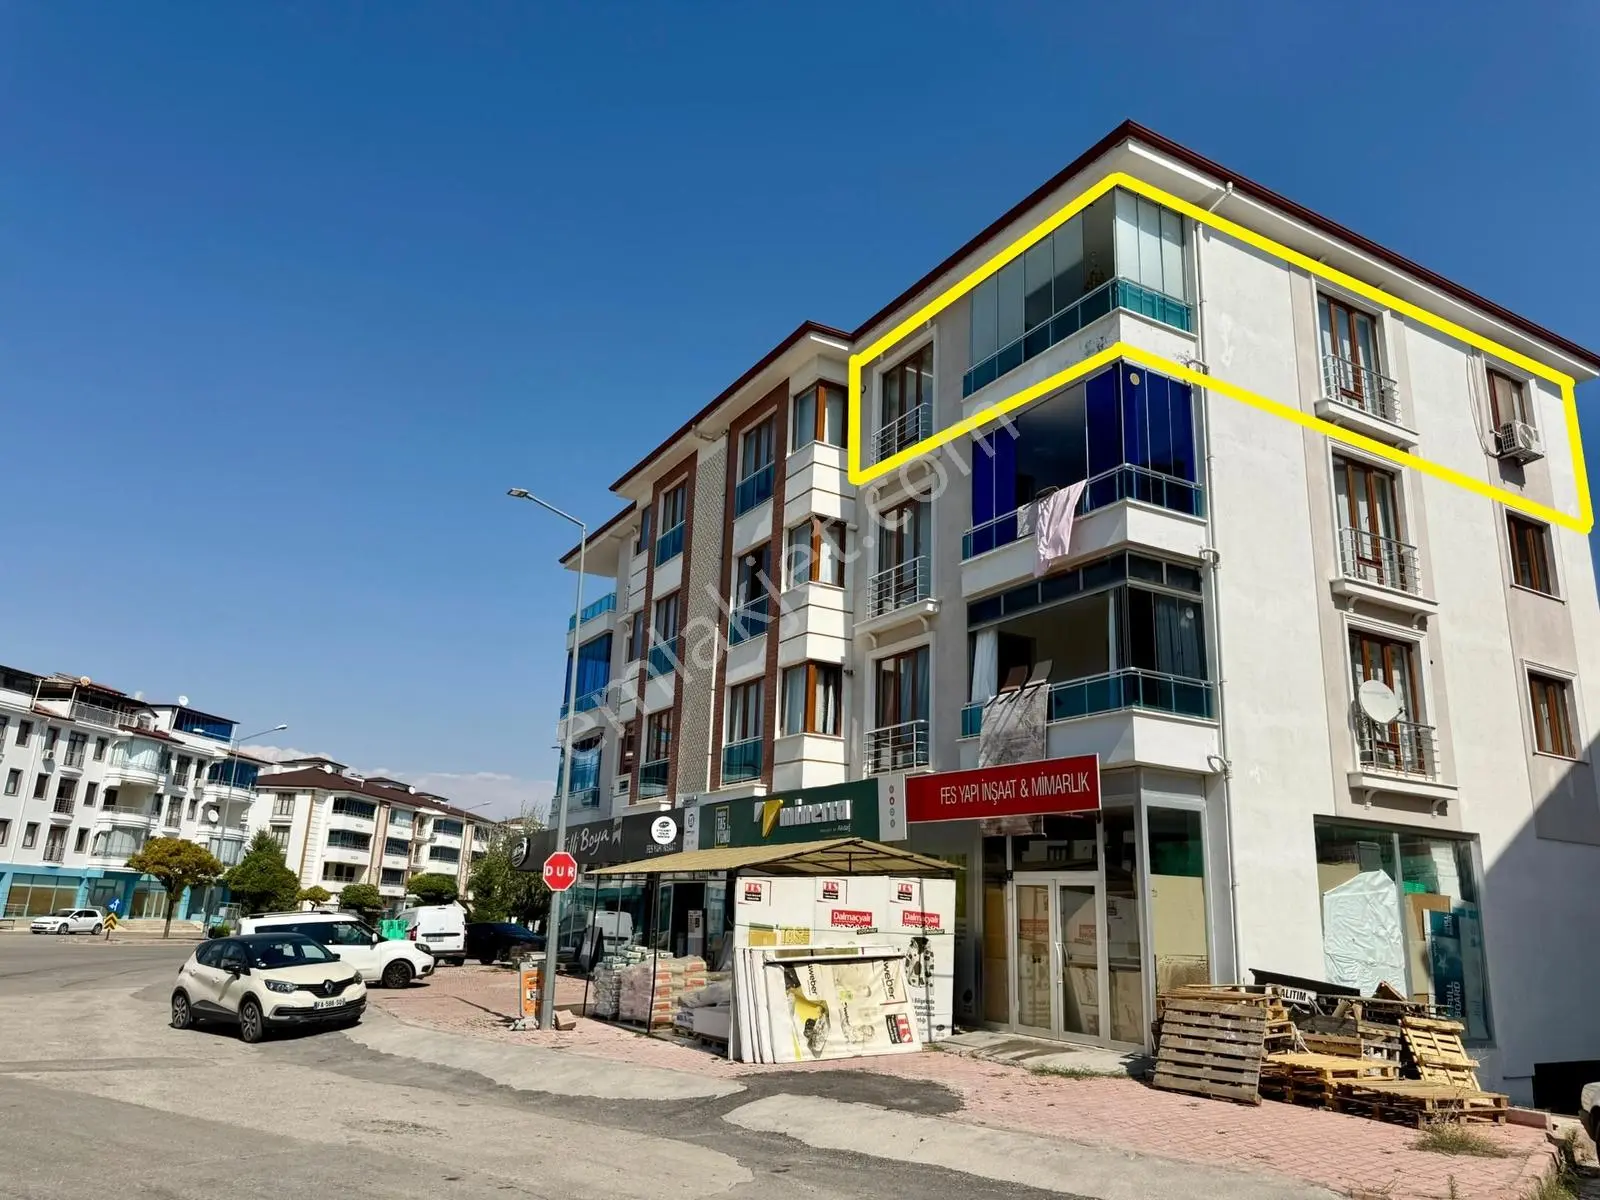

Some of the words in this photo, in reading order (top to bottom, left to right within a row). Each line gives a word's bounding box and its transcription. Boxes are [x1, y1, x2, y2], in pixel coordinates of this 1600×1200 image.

[940, 786, 957, 805] FES
[959, 784, 980, 803] YAPI
[981, 779, 1017, 806] İNŞAAT
[1020, 780, 1029, 798] &
[1031, 771, 1090, 797] MİMARLIK
[580, 827, 609, 856] Boya
[545, 866, 575, 878] DUR
[883, 963, 896, 1000] weber
[1279, 988, 1308, 1002] ALITIM
